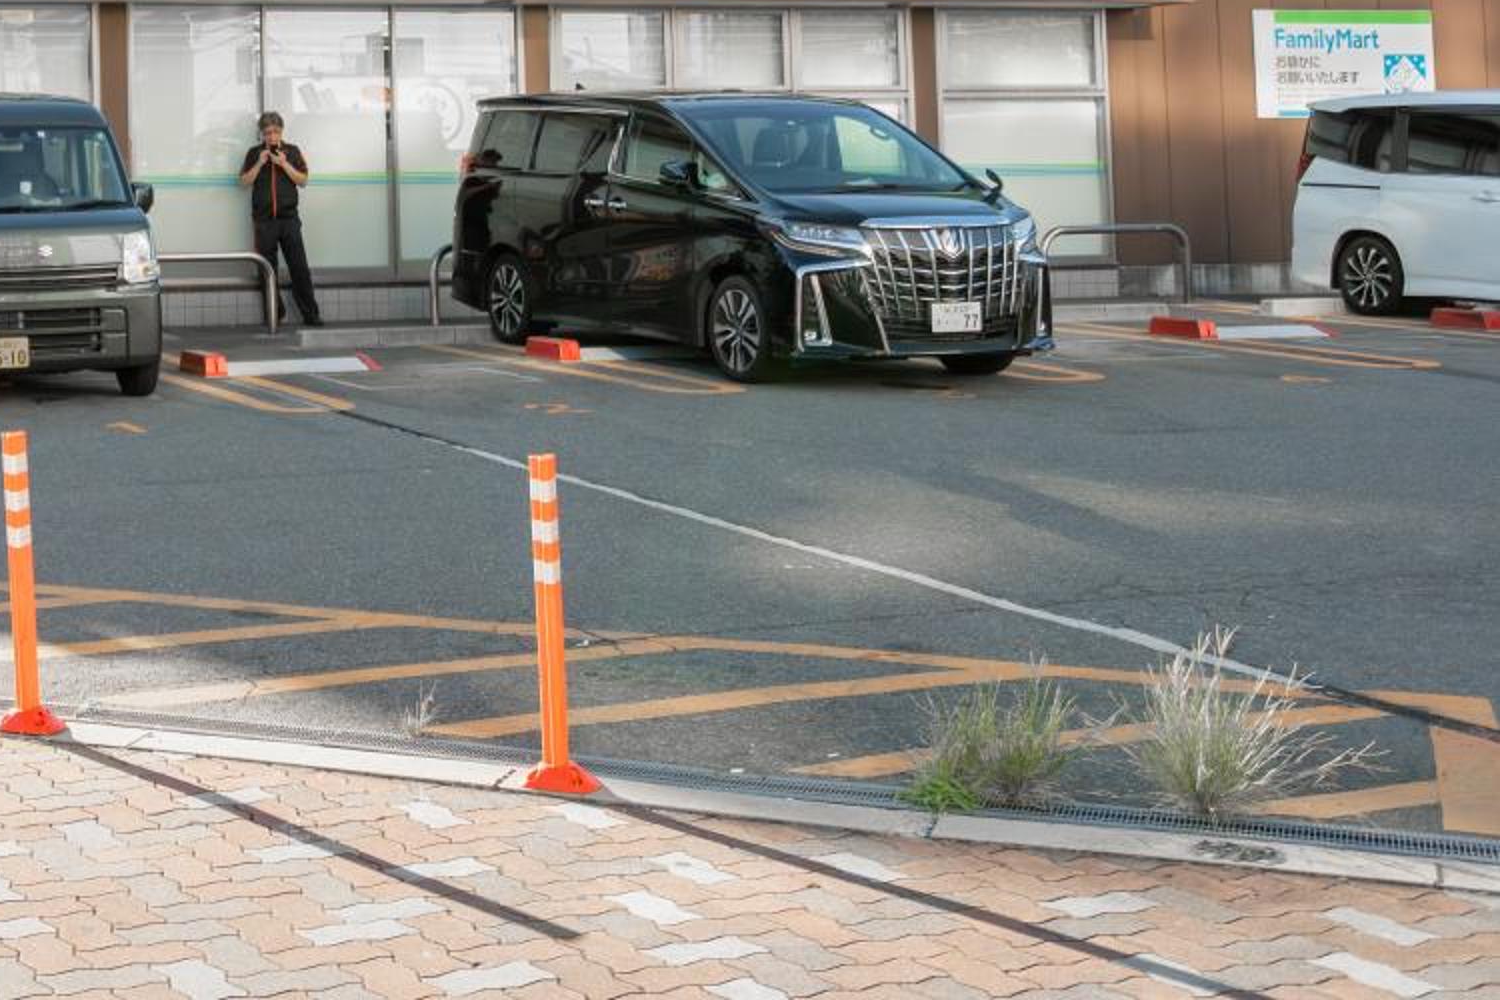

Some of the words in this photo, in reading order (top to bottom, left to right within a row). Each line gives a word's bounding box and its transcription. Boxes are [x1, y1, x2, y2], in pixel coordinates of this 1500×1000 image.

[1274, 28, 1380, 54] FamilyMart
[1276, 70, 1360, 85] お願いいたします
